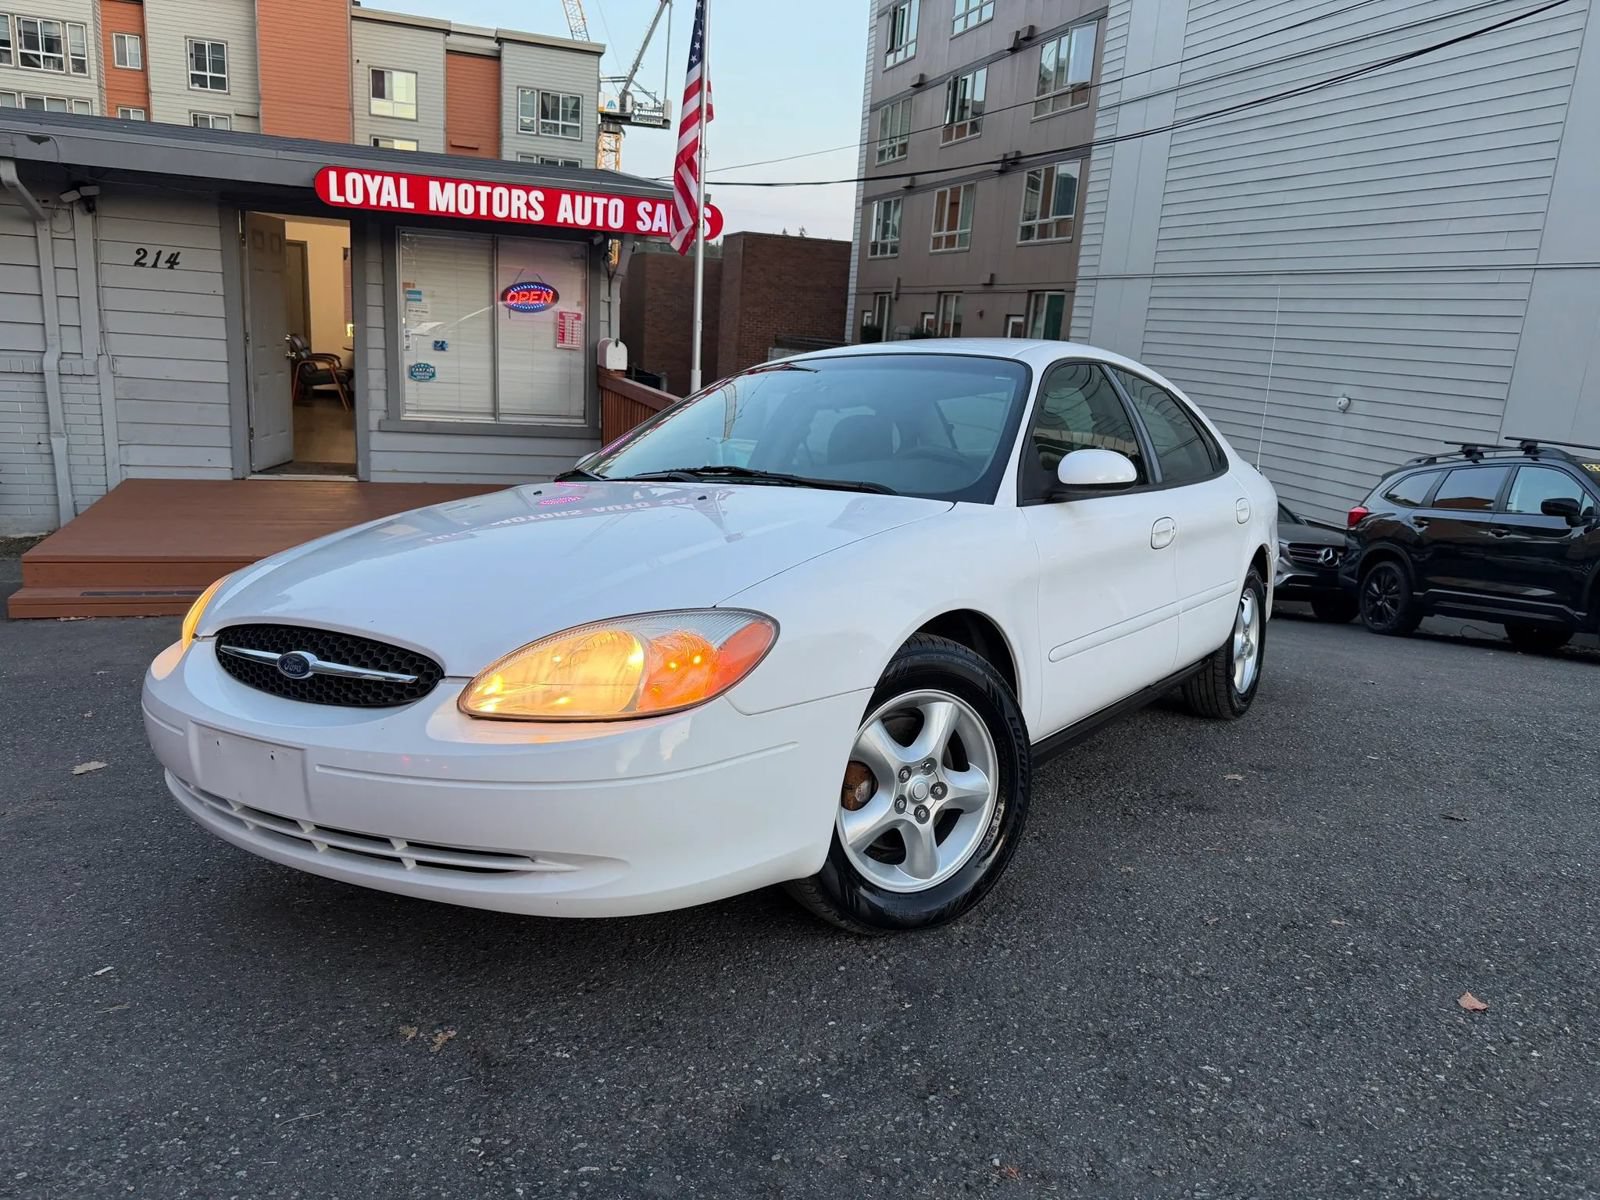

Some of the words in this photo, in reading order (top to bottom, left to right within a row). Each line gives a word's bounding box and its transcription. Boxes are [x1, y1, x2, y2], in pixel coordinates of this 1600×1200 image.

[328, 171, 415, 209] LOYAL
[428, 181, 545, 222] MOTORS
[556, 193, 625, 230] AUTO
[636, 201, 712, 237] SAS
[134, 247, 181, 270] 214
[507, 289, 554, 304] OPEN
